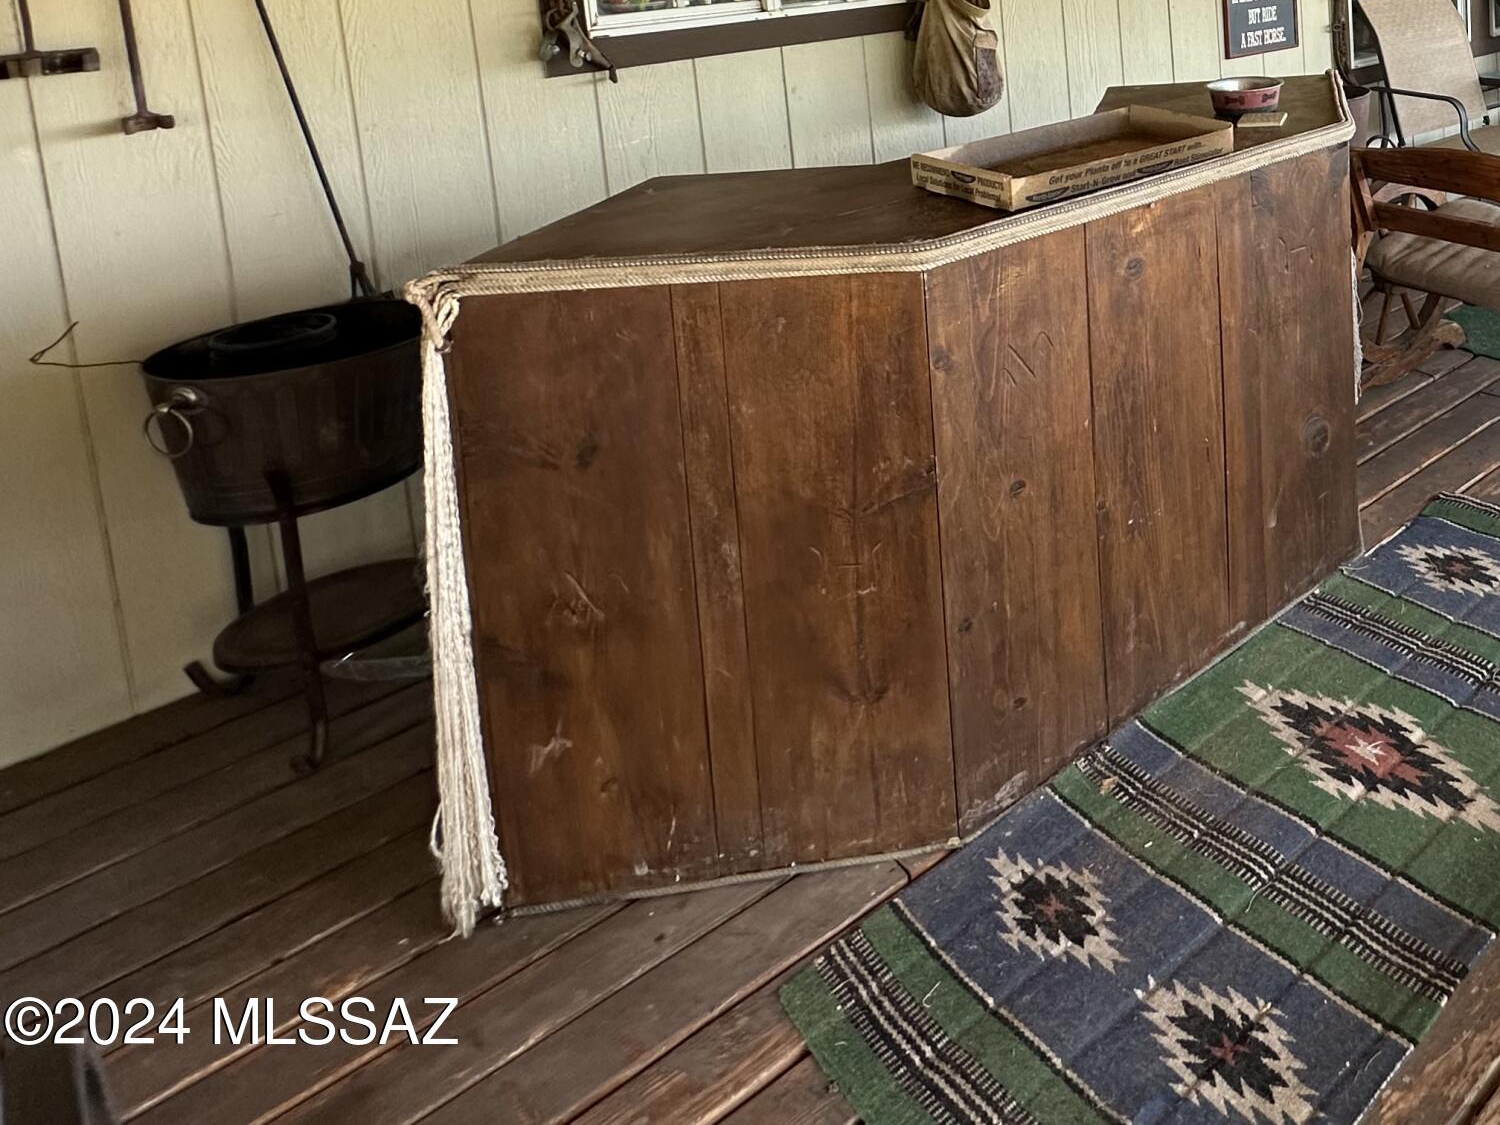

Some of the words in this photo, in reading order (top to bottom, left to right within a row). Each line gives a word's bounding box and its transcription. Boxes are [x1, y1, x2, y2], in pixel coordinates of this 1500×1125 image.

[1247, 7, 1261, 25] BUT
[1261, 5, 1278, 23] RIDE
[1240, 32, 1247, 49] A
[1246, 29, 1263, 48] FAST
[1049, 171, 1064, 185] Get
[1064, 169, 1083, 182] your
[1084, 163, 1110, 178] Plants
[1139, 150, 1163, 164] GREAT
[1163, 144, 1187, 159] START
